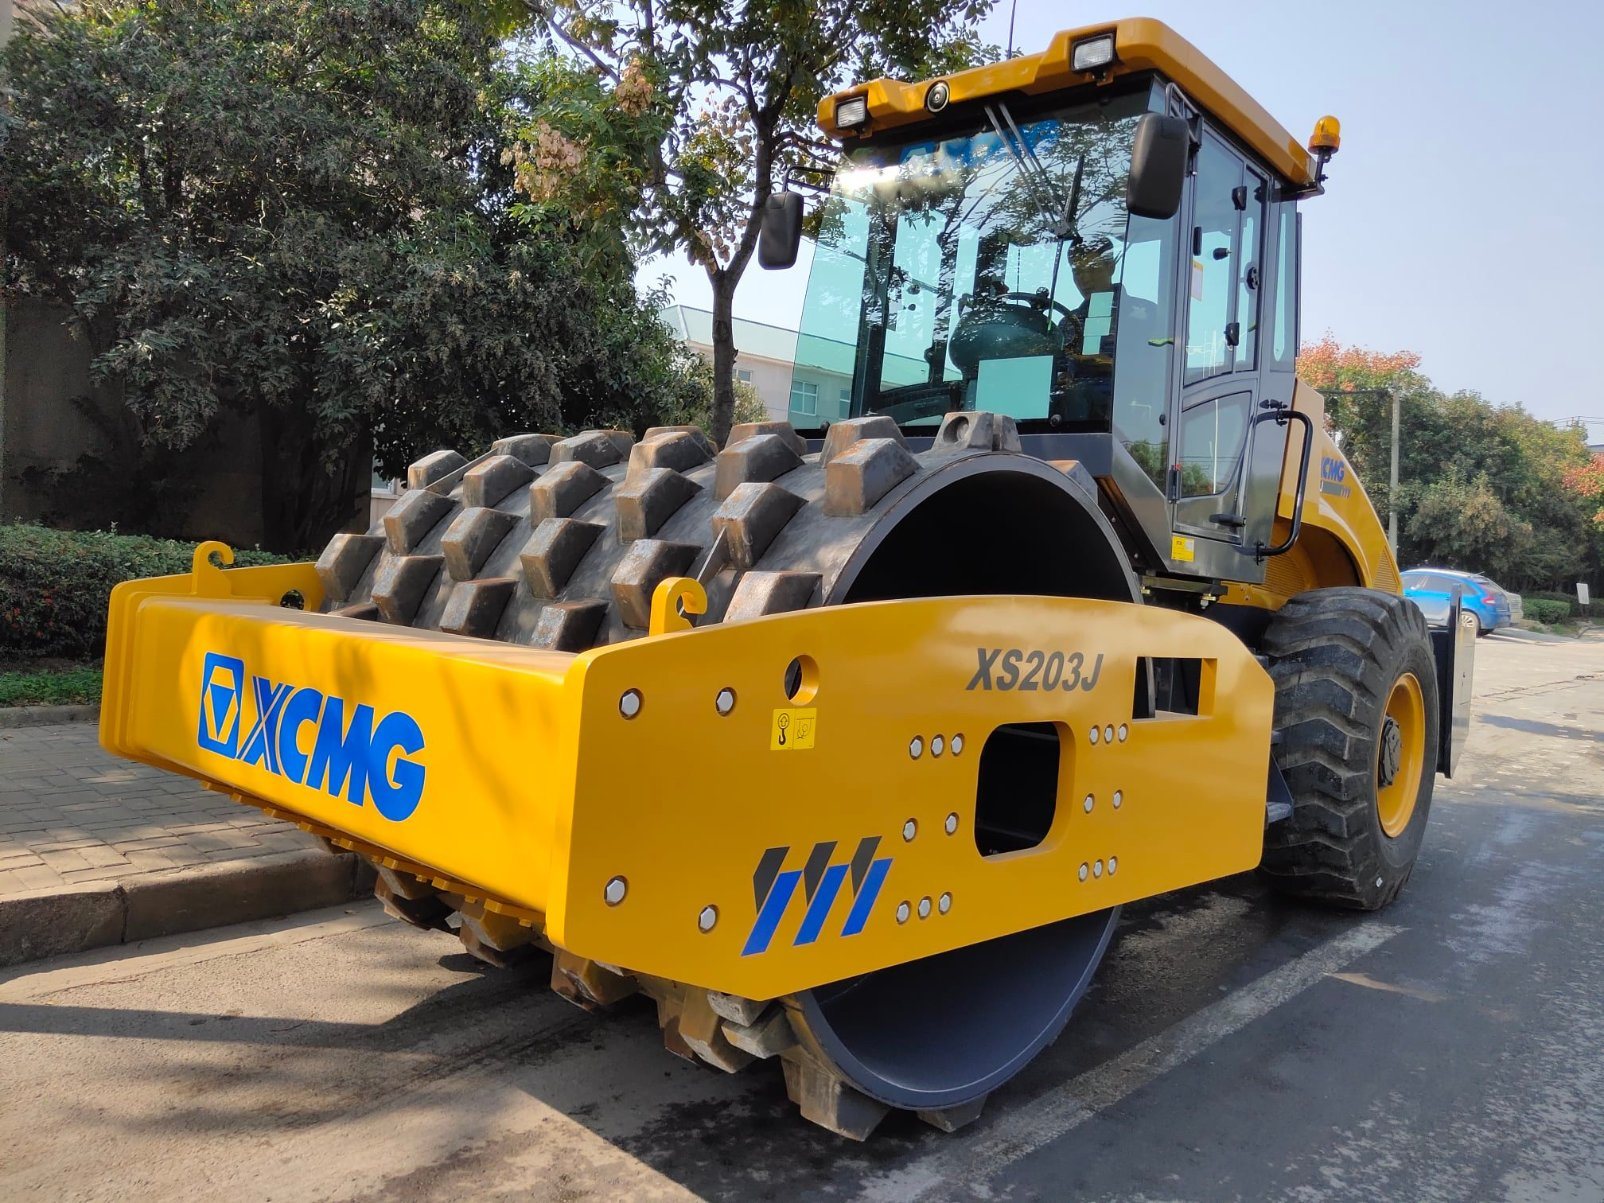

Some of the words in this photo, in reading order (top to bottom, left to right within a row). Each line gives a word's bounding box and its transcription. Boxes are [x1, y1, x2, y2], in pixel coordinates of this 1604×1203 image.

[1320, 456, 1345, 482] CMG
[965, 647, 1104, 692] XS203J
[236, 675, 426, 822] XCMG
